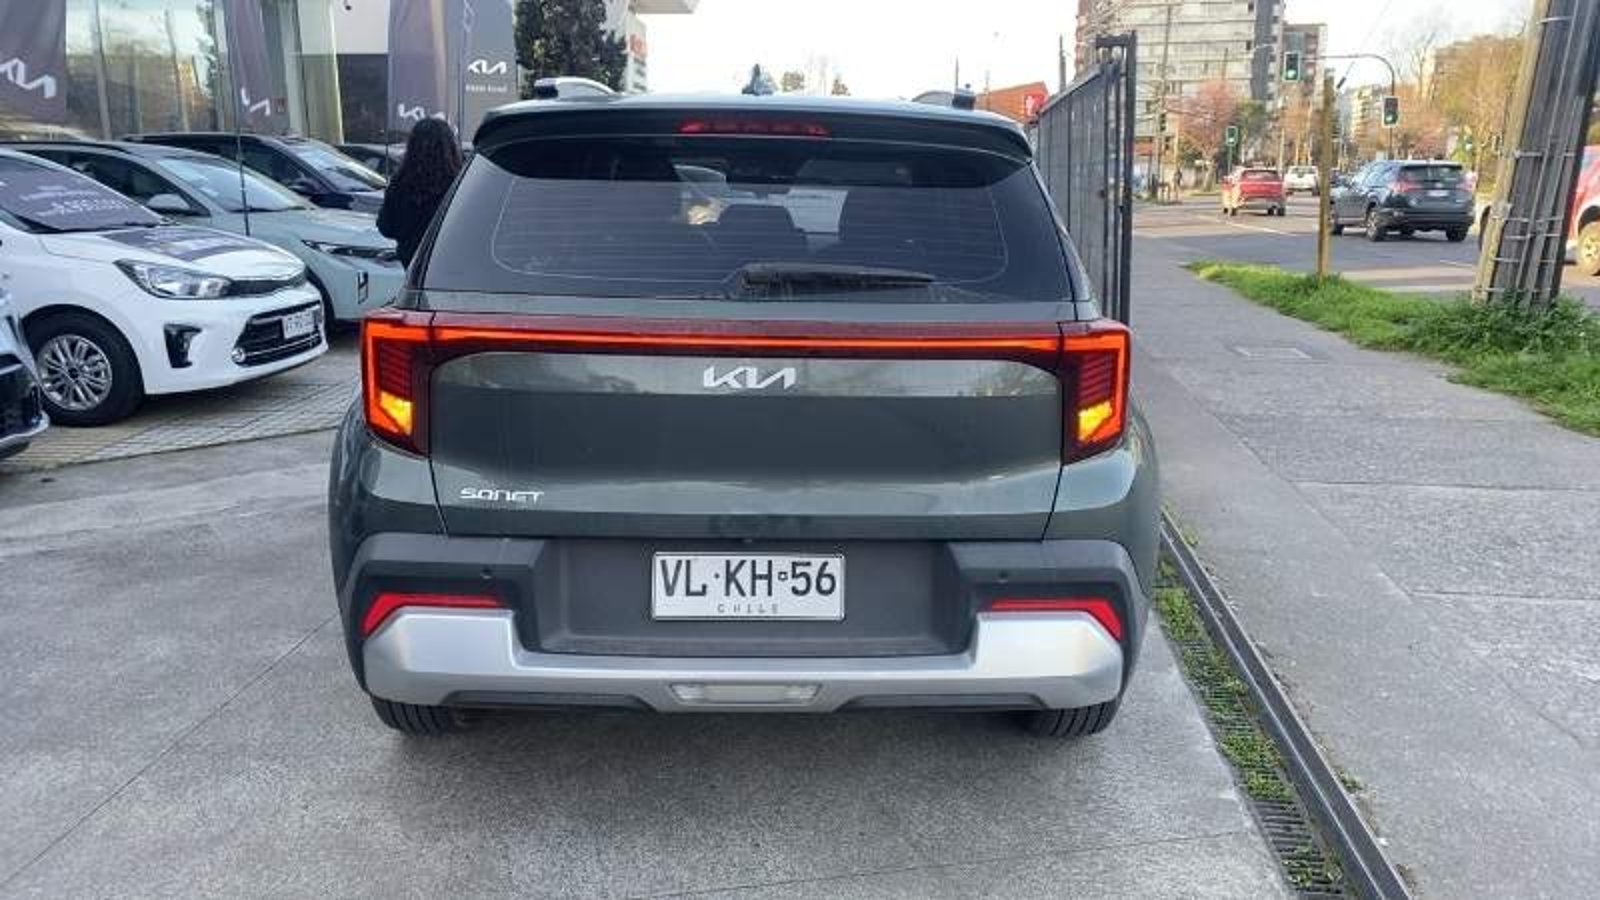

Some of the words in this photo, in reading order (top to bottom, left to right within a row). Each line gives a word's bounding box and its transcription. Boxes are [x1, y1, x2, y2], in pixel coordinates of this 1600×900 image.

[398, 103, 446, 120] KI
[703, 366, 797, 389] KIA
[460, 487, 544, 504] SONET
[717, 603, 779, 614] CHILE
